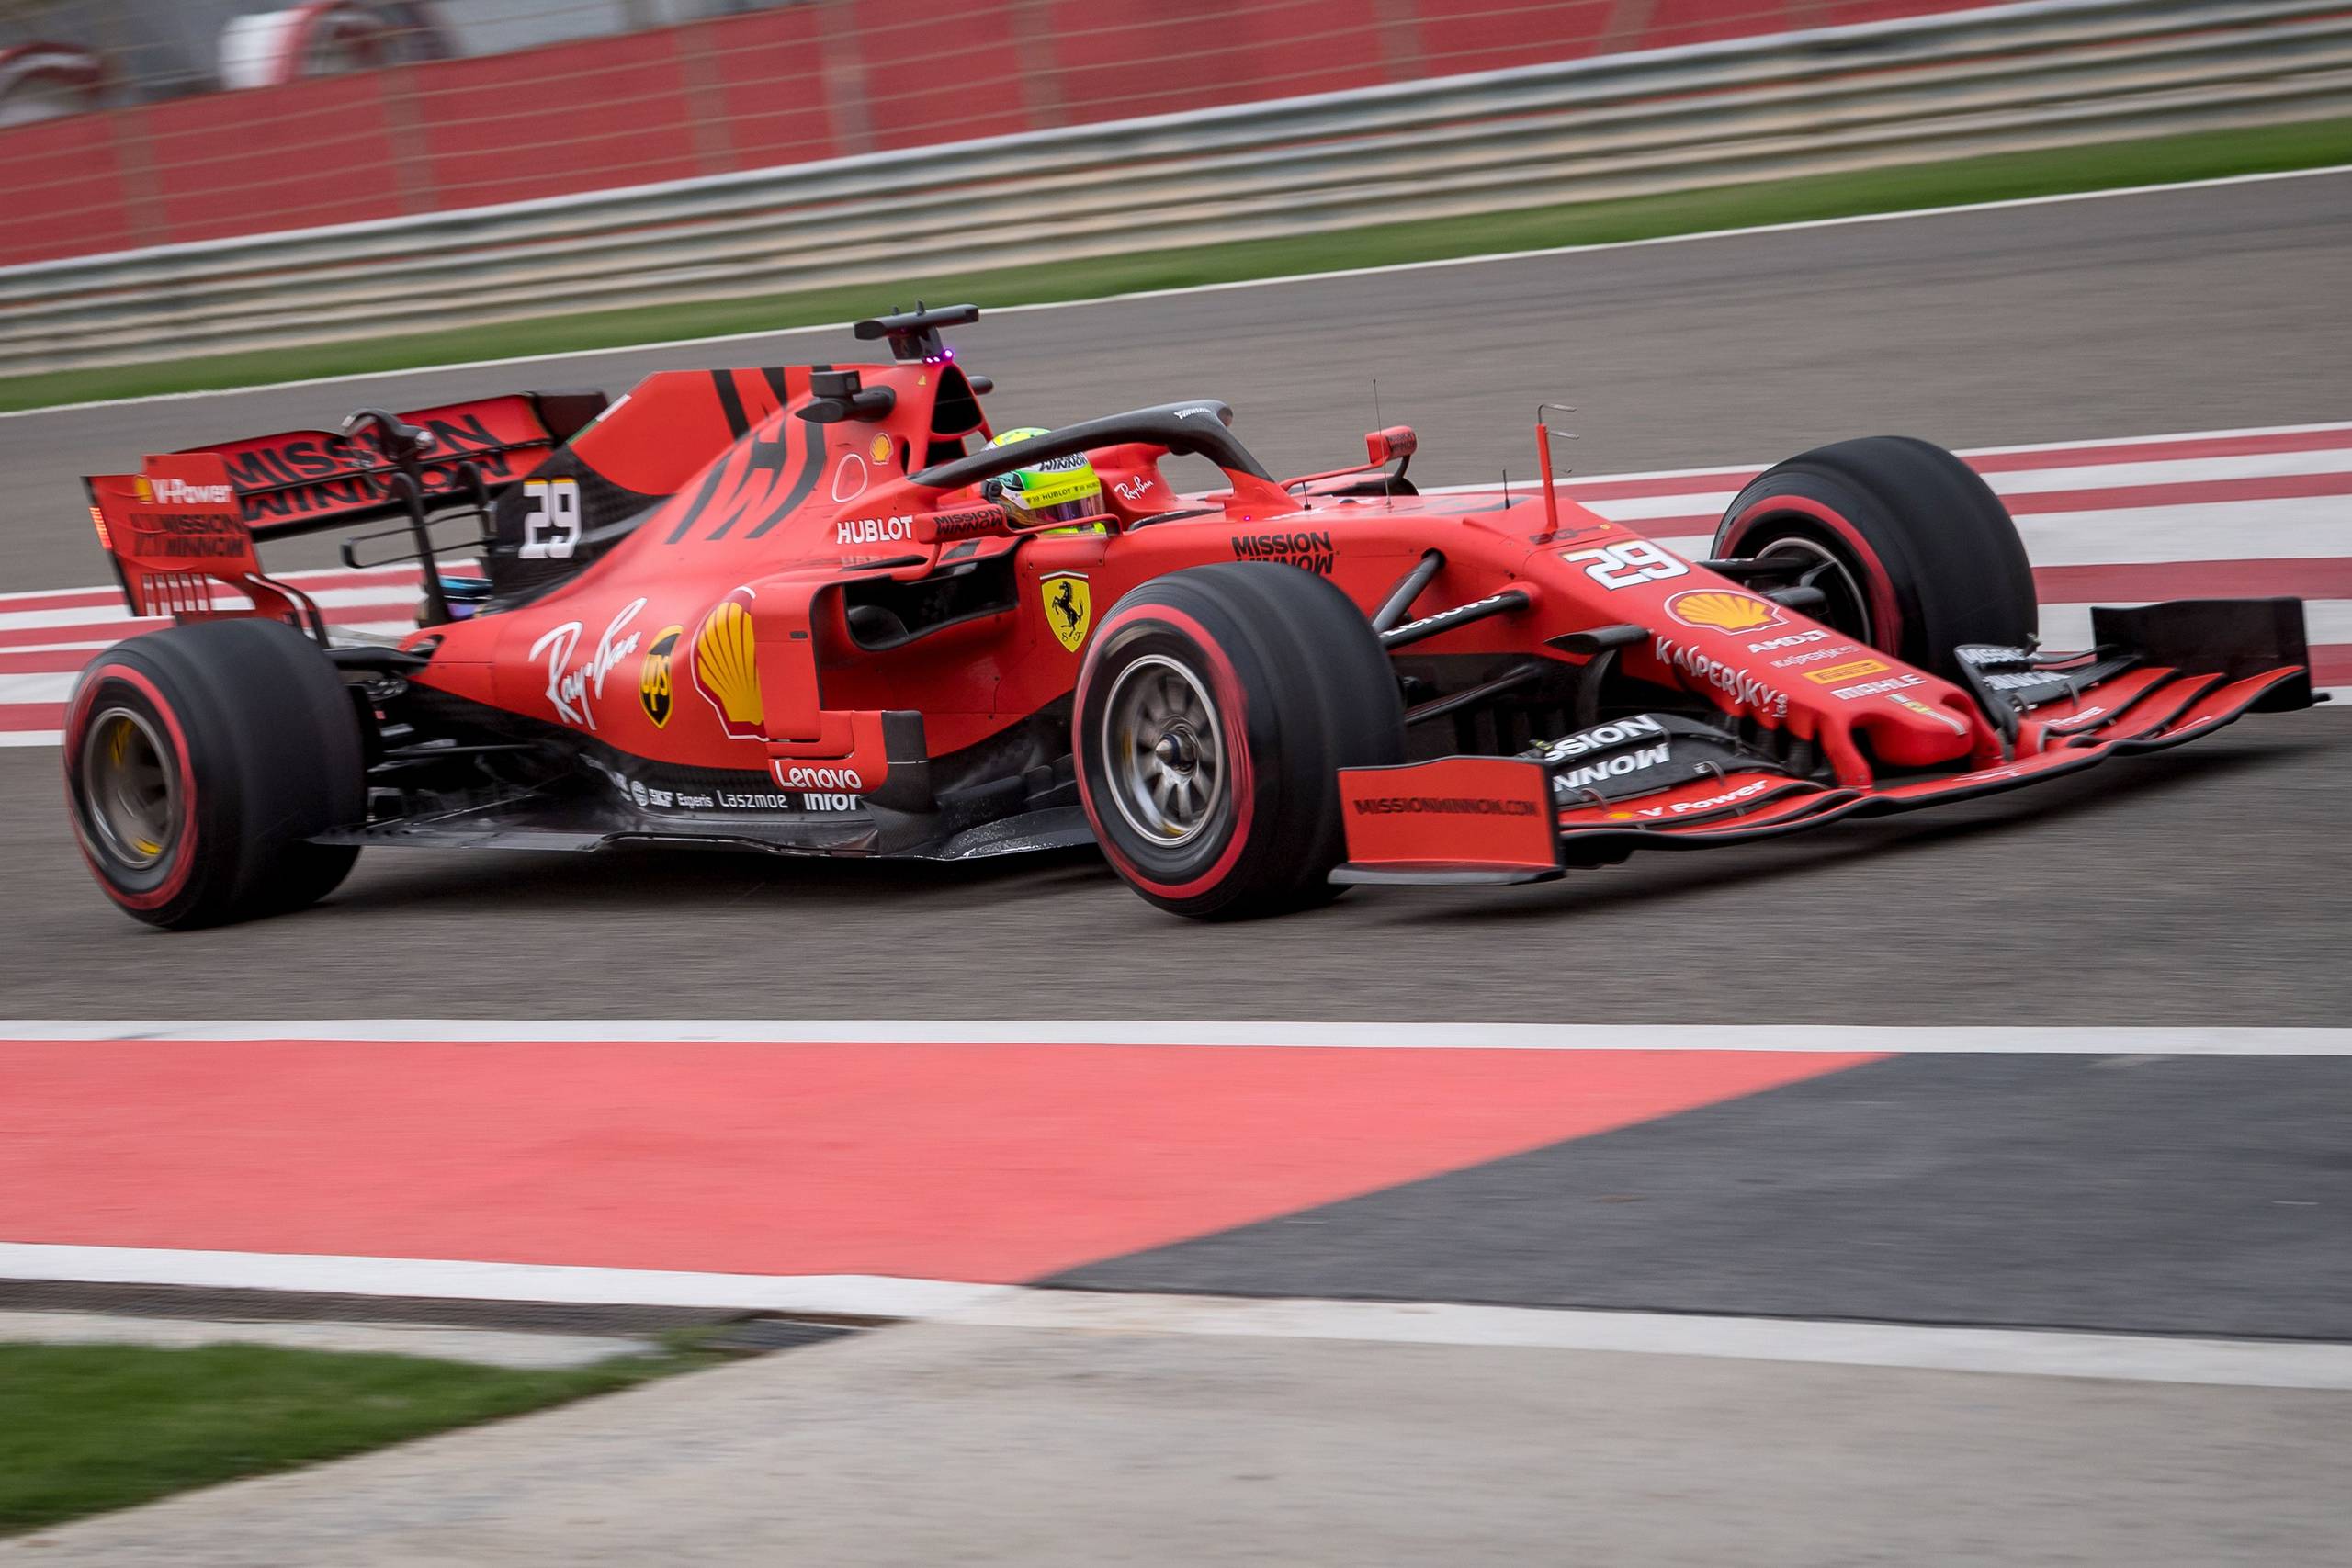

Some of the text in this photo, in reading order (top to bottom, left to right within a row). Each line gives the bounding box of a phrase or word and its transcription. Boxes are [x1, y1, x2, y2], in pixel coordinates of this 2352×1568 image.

[226, 414, 506, 491] MISSIN
[518, 479, 582, 558] 29
[836, 515, 913, 545] HUBLOT
[933, 507, 1003, 525] MISSION
[937, 517, 1003, 536] WINNOW
[1231, 531, 1334, 558] MISSION
[1560, 539, 1691, 591] 29
[1656, 635, 1778, 707] KASPERSKY
[1544, 714, 1664, 761] SSION
[775, 761, 862, 789] Lenovo
[1553, 743, 1671, 792] NNOW
[717, 789, 788, 809] Laszmoe
